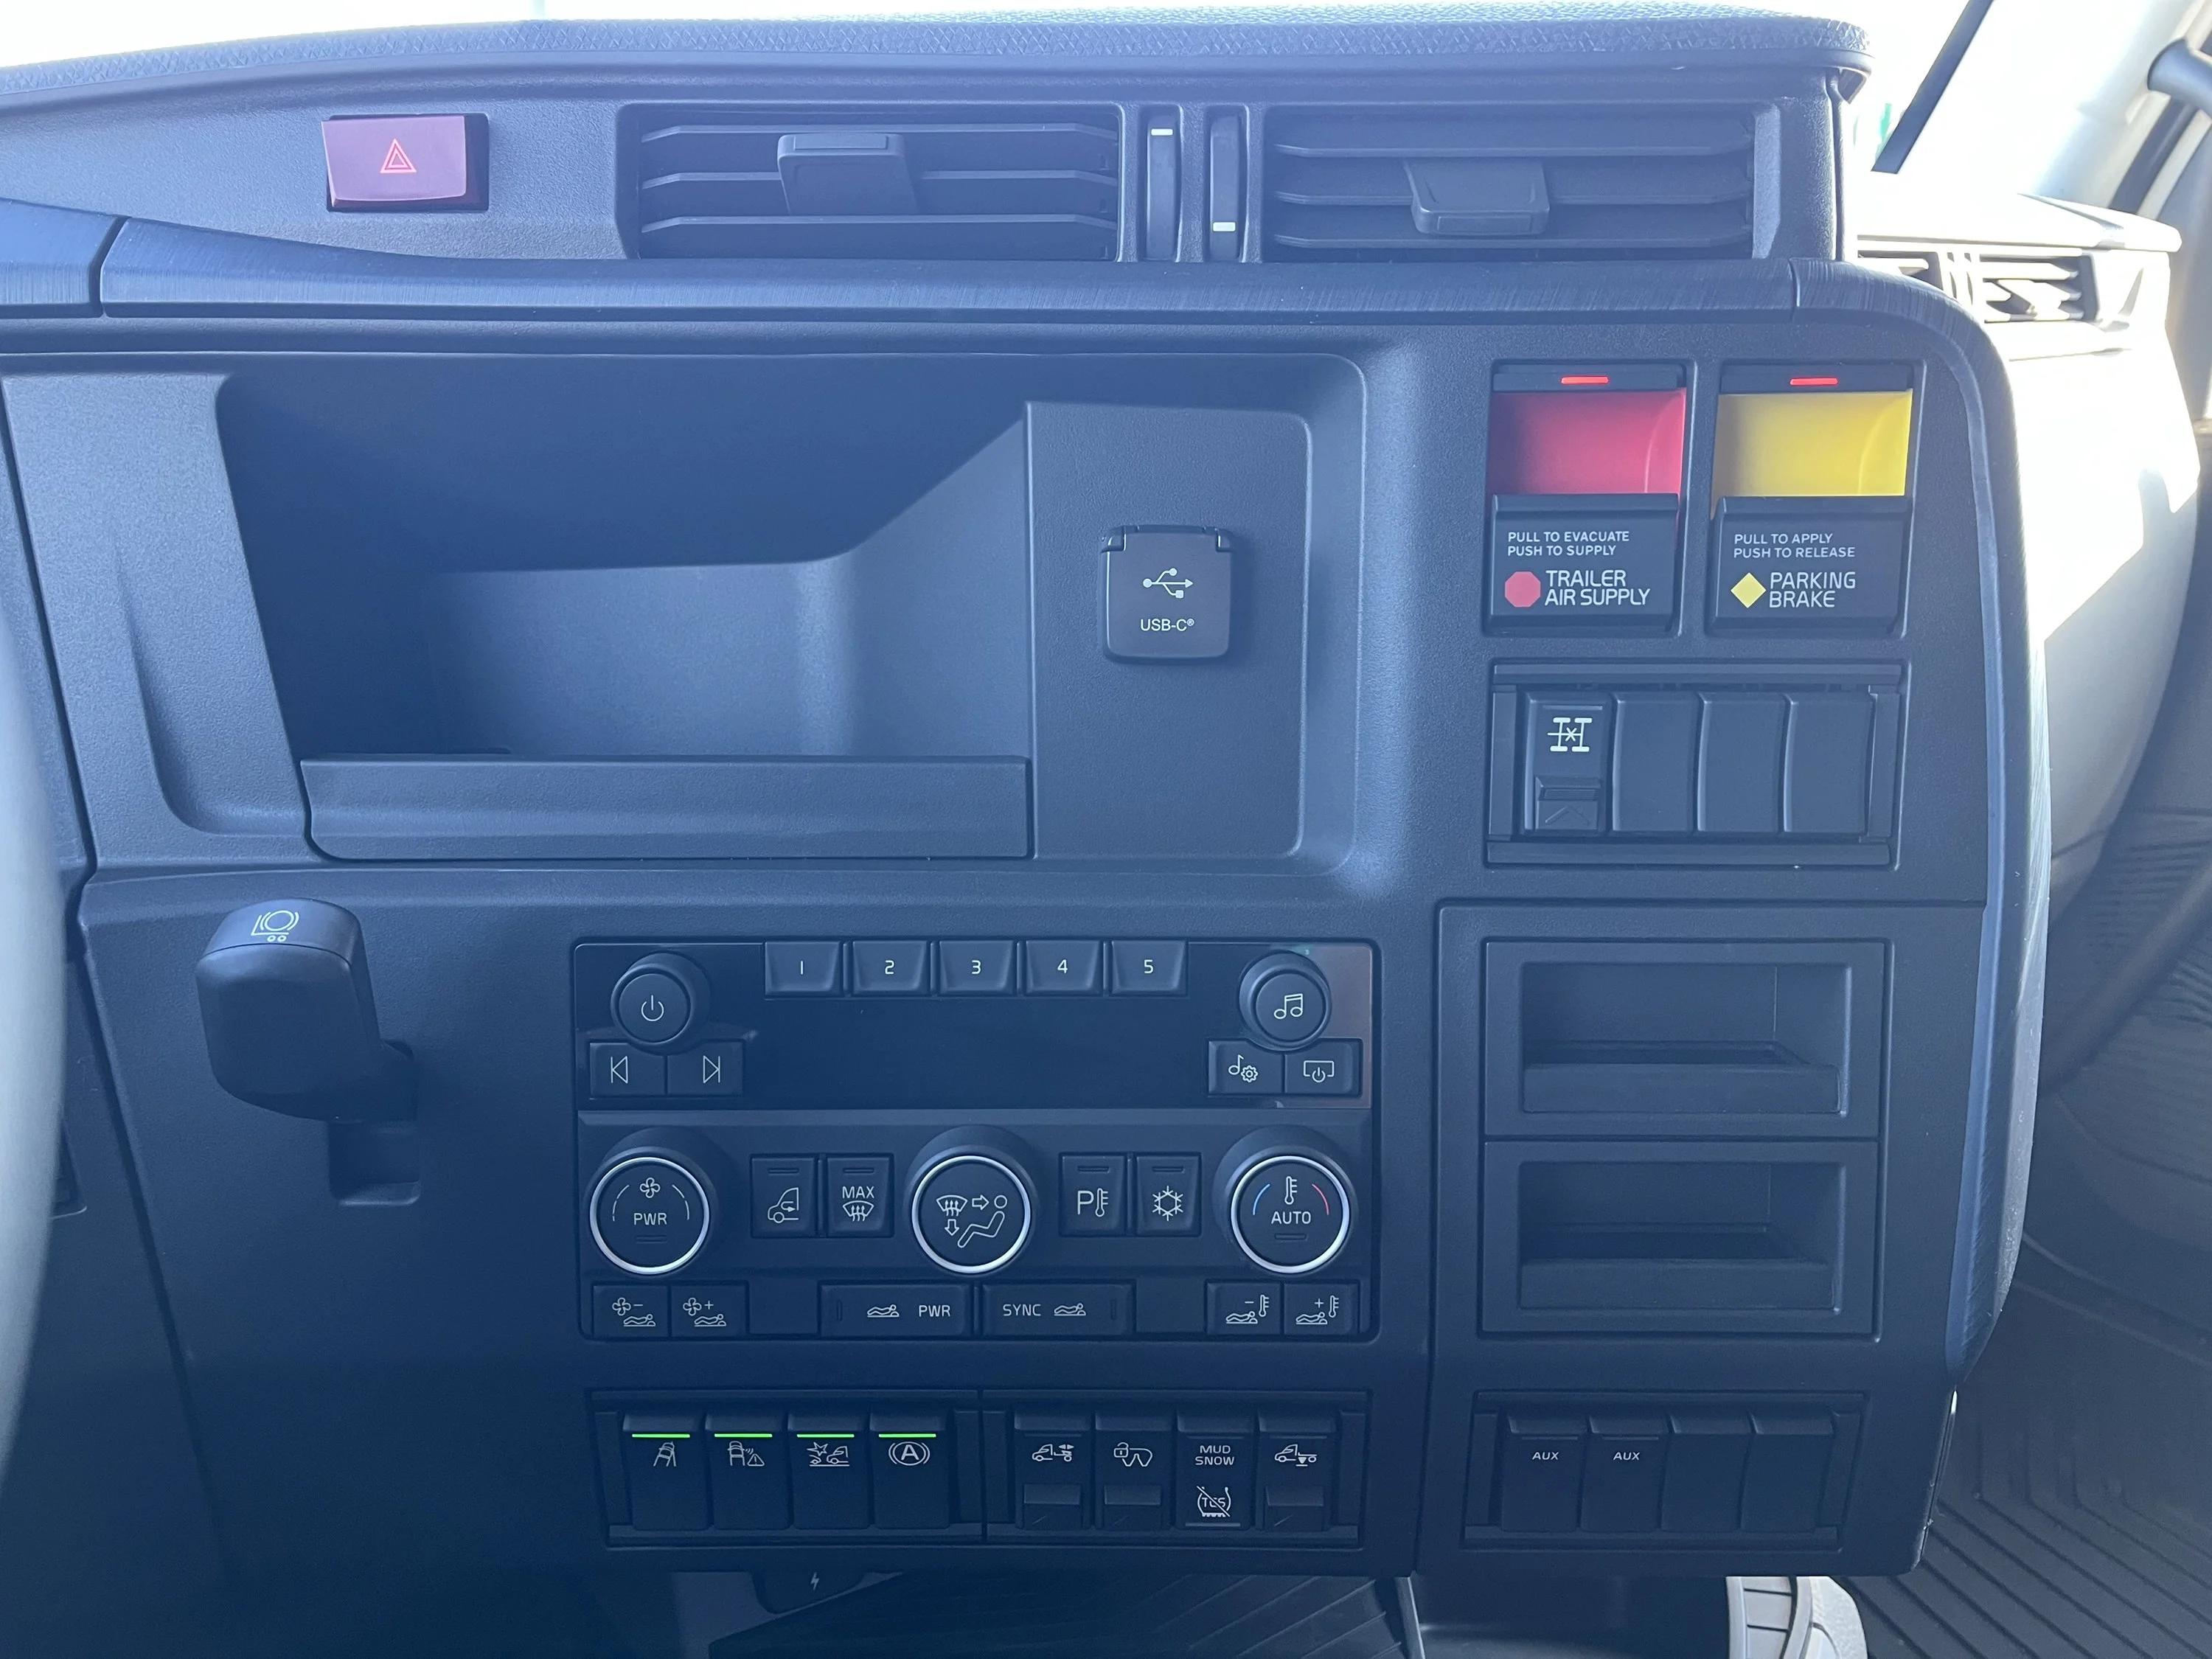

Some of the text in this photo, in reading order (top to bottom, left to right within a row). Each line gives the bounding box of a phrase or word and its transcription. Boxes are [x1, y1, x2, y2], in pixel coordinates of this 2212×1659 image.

[1508, 530, 1630, 543] PULL TO EVACUATE
[1734, 533, 1833, 545] PULL TO APPLY
[1507, 545, 1616, 557] PUSH TO SUPPLY
[1733, 546, 1856, 559] PUSH TO RELEASE
[1545, 569, 1627, 588] TRAILER
[1770, 571, 1856, 590] PARKING
[1544, 588, 1651, 606] AIR SUPPLY
[1769, 590, 1836, 608] BRAKE
[885, 959, 895, 975] 2
[971, 959, 981, 975] 3
[1057, 959, 1068, 974] 4
[1144, 959, 1154, 974] 5
[841, 1186, 875, 1200] MAX
[1077, 1189, 1094, 1215] P
[633, 1212, 667, 1225] PWR
[1270, 1211, 1312, 1225] AUTO
[919, 1304, 950, 1318] PWR
[1003, 1304, 1041, 1316] SYNC
[900, 1444, 919, 1461] A
[1200, 1444, 1231, 1454] MUD
[1531, 1451, 1559, 1461] AUX
[1194, 1455, 1235, 1466] SNOW
[1613, 1452, 1640, 1461] AUX
